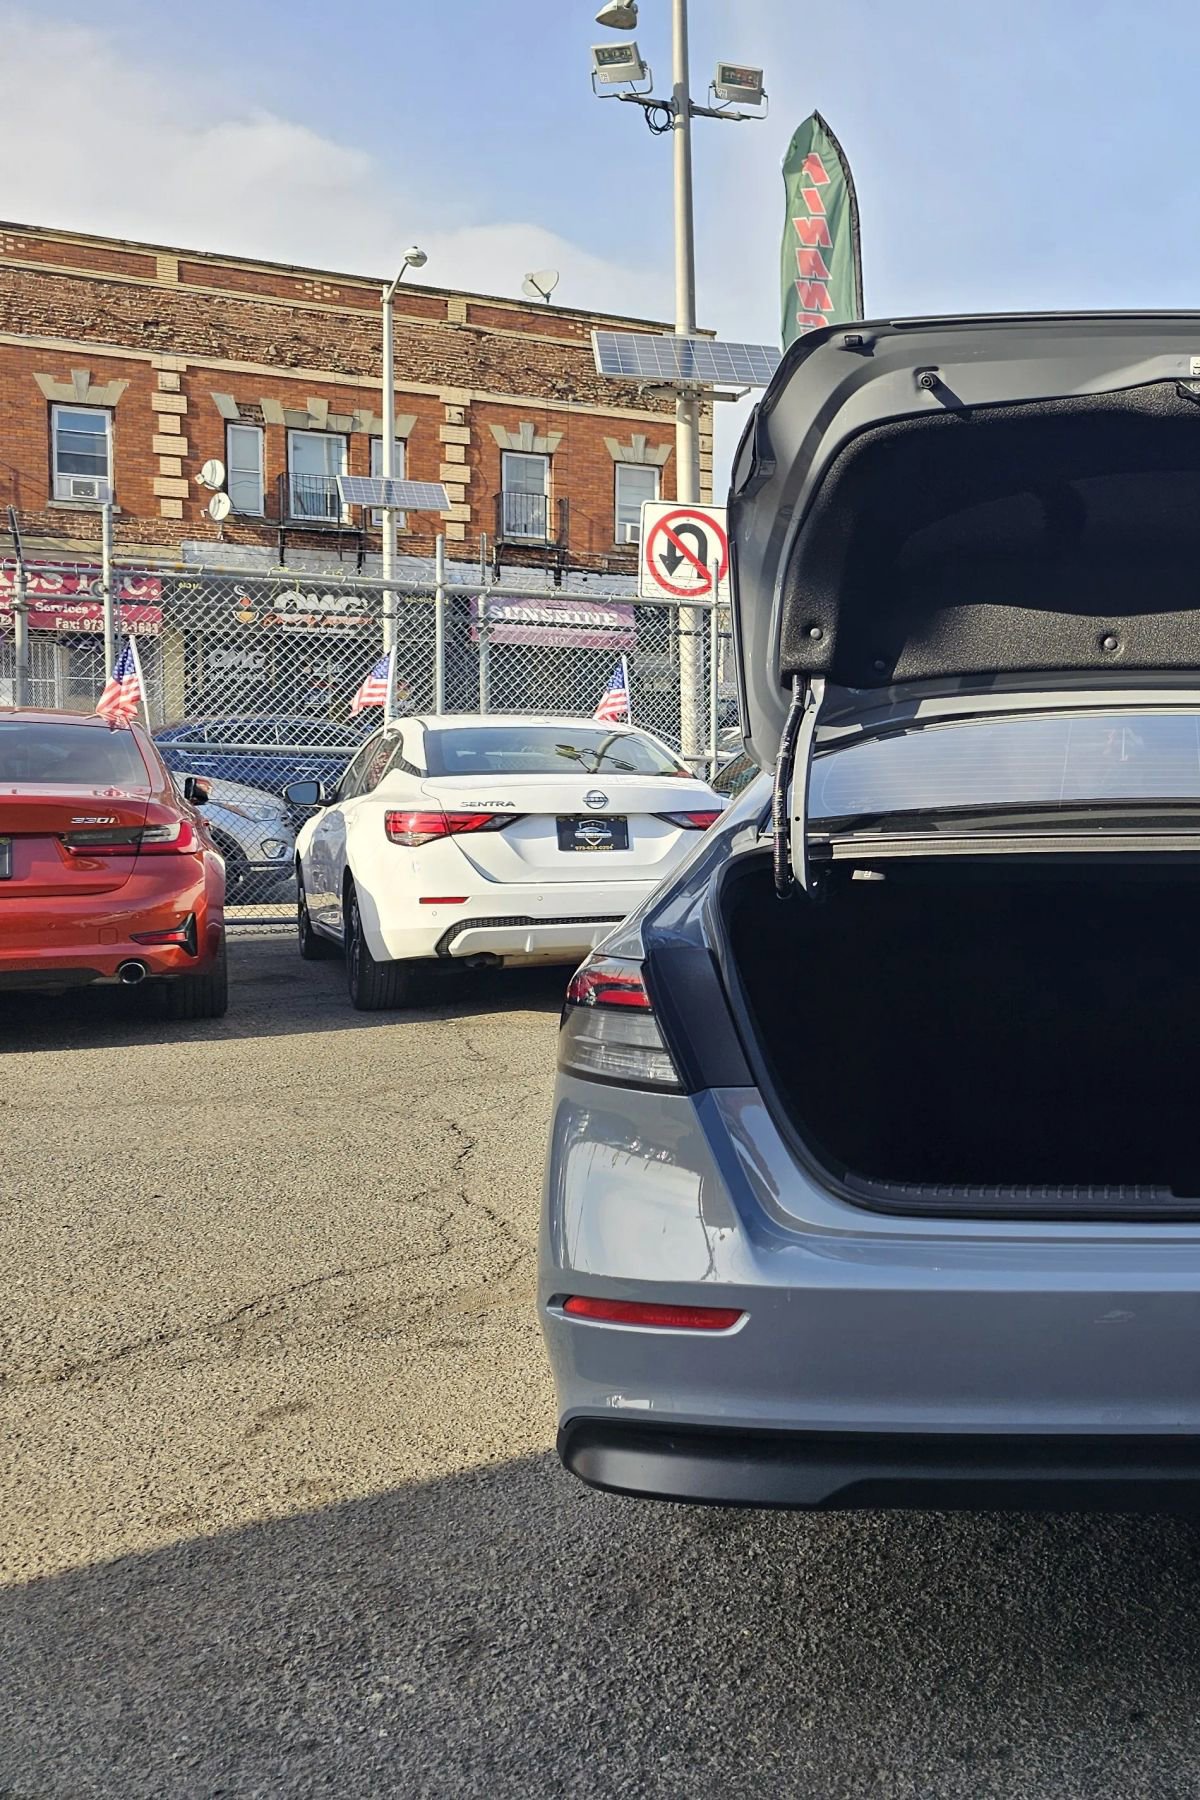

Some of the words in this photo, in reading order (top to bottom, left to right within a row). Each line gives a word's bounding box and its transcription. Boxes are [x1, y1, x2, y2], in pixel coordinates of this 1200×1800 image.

[34, 601, 88, 615] Services
[489, 605, 619, 627] SUNSHINE
[55, 617, 81, 630] Fax:
[460, 800, 516, 808] SENTRA
